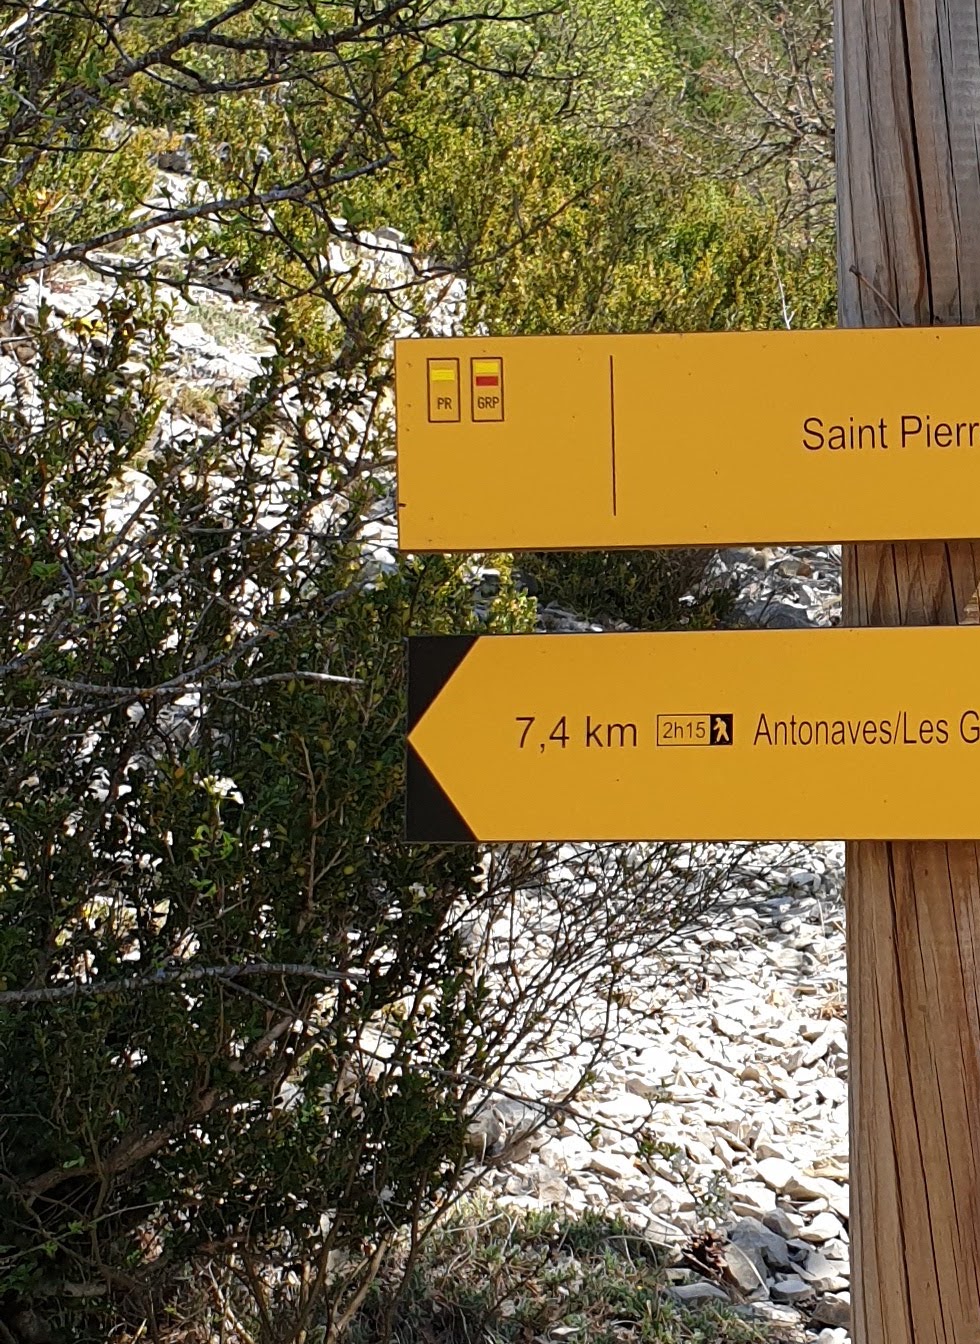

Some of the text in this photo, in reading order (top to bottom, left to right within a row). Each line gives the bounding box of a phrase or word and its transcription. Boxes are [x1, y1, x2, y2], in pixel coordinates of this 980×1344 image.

[437, 397, 453, 410] PR
[477, 396, 500, 410] GRP
[802, 416, 889, 451] Saint
[515, 715, 570, 754] 7,4
[585, 715, 637, 748] km
[662, 721, 706, 739] 2h15
[753, 711, 949, 746] Antonaves/Les
